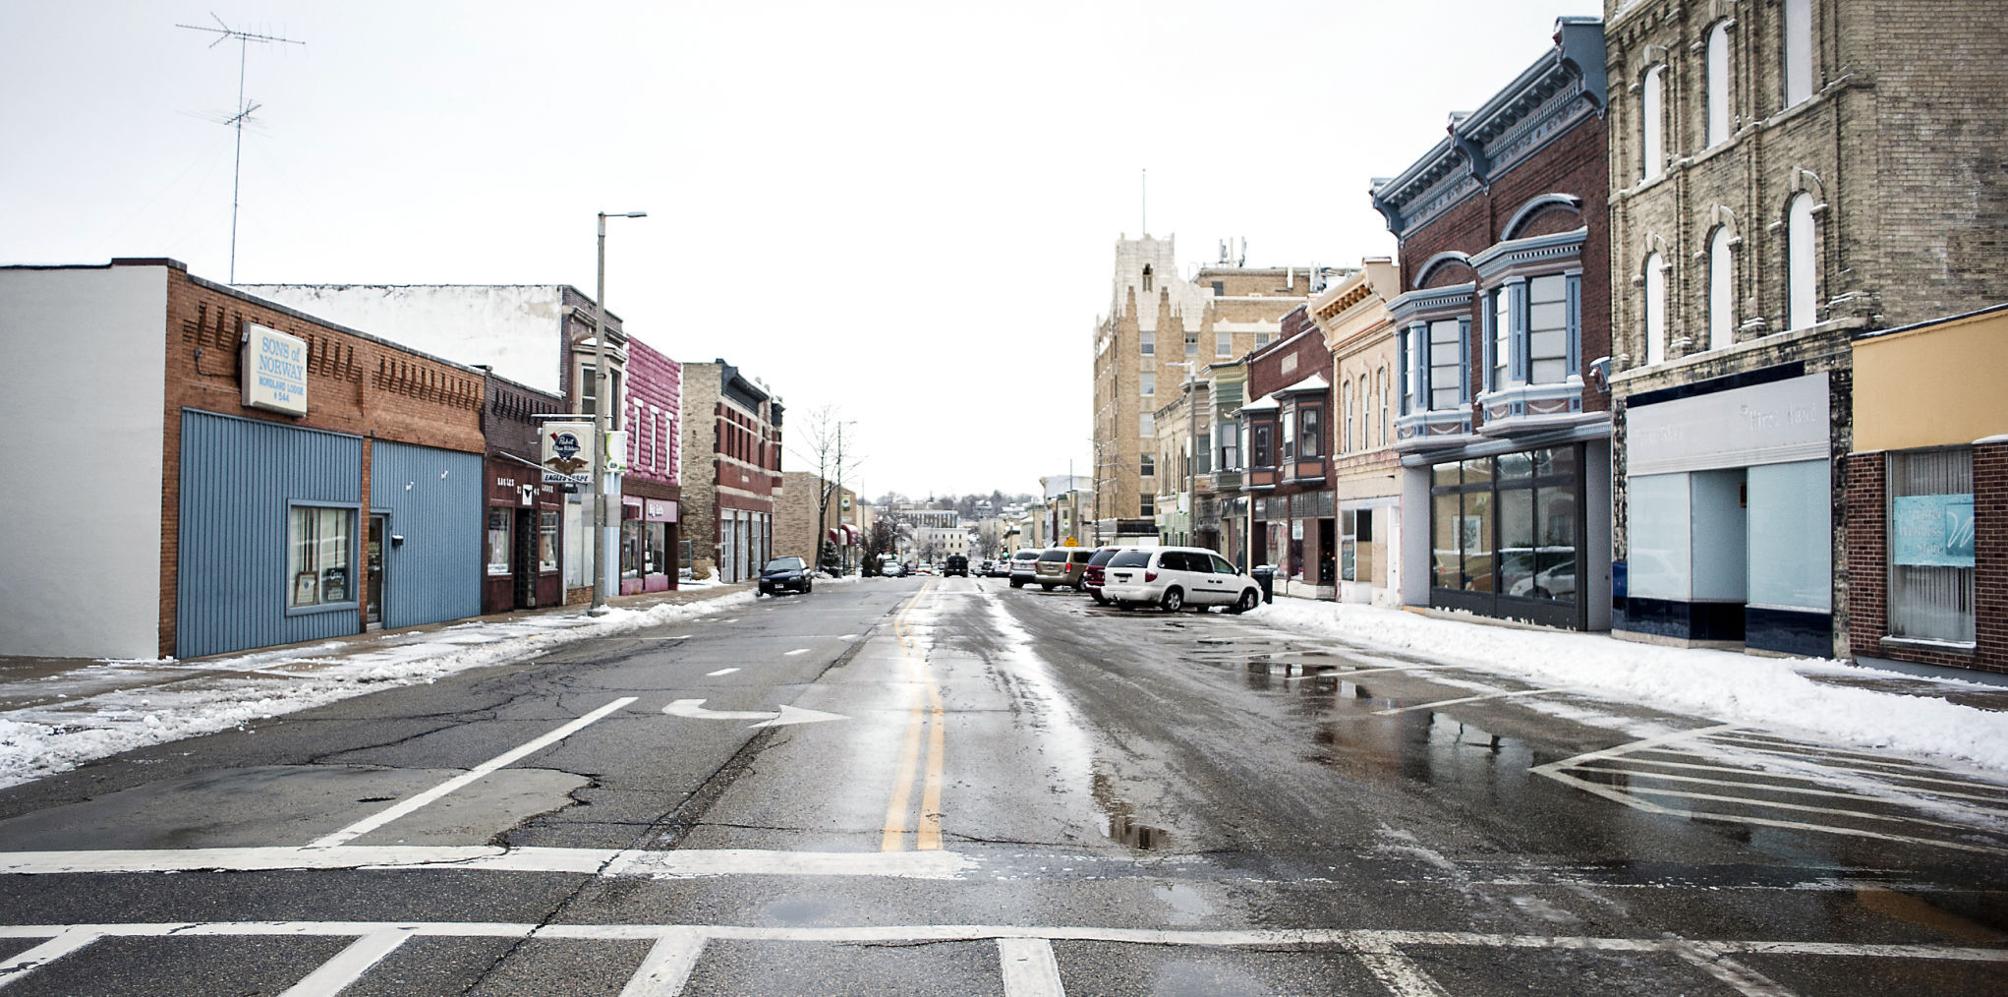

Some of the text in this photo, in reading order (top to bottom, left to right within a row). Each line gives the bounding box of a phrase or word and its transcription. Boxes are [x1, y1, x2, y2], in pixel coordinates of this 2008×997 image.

[262, 336, 300, 361] SONS of
[259, 353, 304, 381] NORWAY
